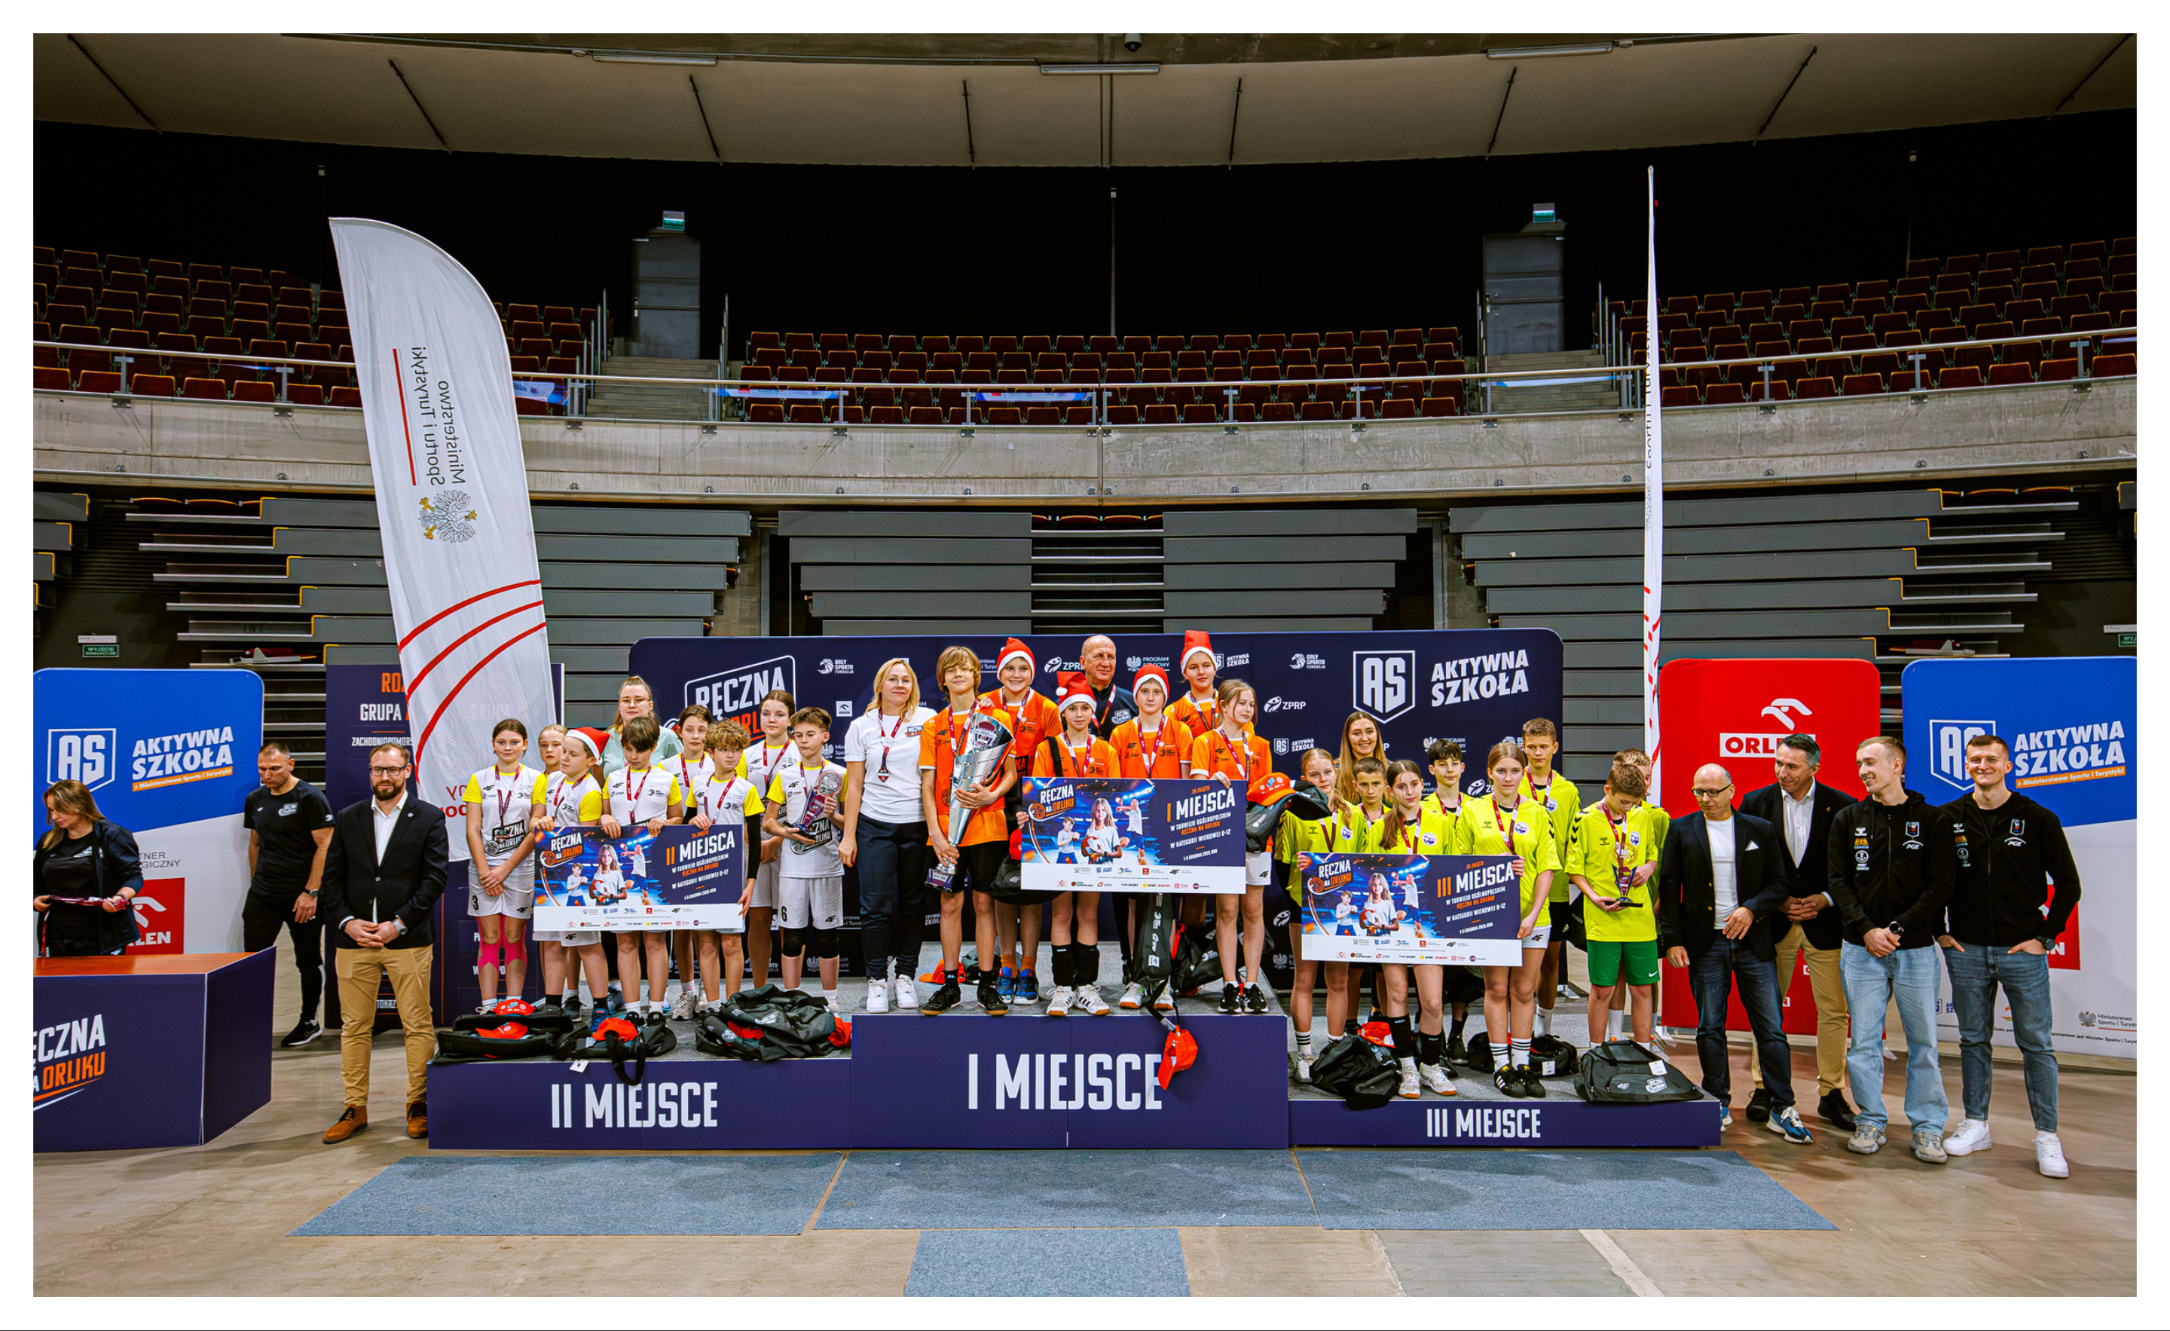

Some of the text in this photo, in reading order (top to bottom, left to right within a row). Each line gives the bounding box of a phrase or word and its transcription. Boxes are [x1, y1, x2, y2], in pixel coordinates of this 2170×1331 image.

[1226, 653, 1250, 661] AKTYWNA
[1226, 659, 1250, 667] SZKOŁA
[1431, 649, 1529, 682] AKTYWNA
[695, 666, 786, 721] RĘCZNA
[1363, 657, 1406, 713] AS
[1431, 669, 1529, 707] SZKOŁA
[360, 703, 402, 721] GRUPA
[1282, 701, 1306, 710] ZPRP
[132, 726, 234, 758] AKTYWNA
[1276, 739, 1287, 752] AS
[1291, 738, 1315, 746] AKTYWNA
[1291, 743, 1315, 752] SZKOŁA
[2014, 720, 2125, 752] AKTYWNA
[58, 734, 106, 787] AS
[132, 744, 234, 781] SZKOŁA
[2014, 740, 2126, 777] SZKOŁA
[183, 774, 202, 782] Sportu
[2023, 776, 2069, 786] Ministerstwem
[2070, 772, 2090, 781] Sportu
[2095, 768, 2125, 778] Turystyki
[1040, 784, 1074, 807] RĘCZNA
[1045, 797, 1075, 813] NA ORLIKU
[1166, 787, 1236, 823] I MIEJSCA
[550, 832, 582, 853] RĘCZNA
[562, 845, 583, 858] ORLIKU
[666, 830, 735, 866] II MIEJSCA
[1318, 859, 1352, 880] RĘCZNA
[1323, 872, 1352, 886] NA ORLIKU
[1437, 861, 1515, 898] III MIEJSCA
[472, 895, 479, 910] 3
[781, 906, 787, 922] 6
[42, 1051, 107, 1091] ORLIKU
[968, 1053, 1162, 1110] I MIEJSCE
[551, 1082, 718, 1128] II MIEJSCE
[1426, 1108, 1541, 1138] III MIEJSCE
